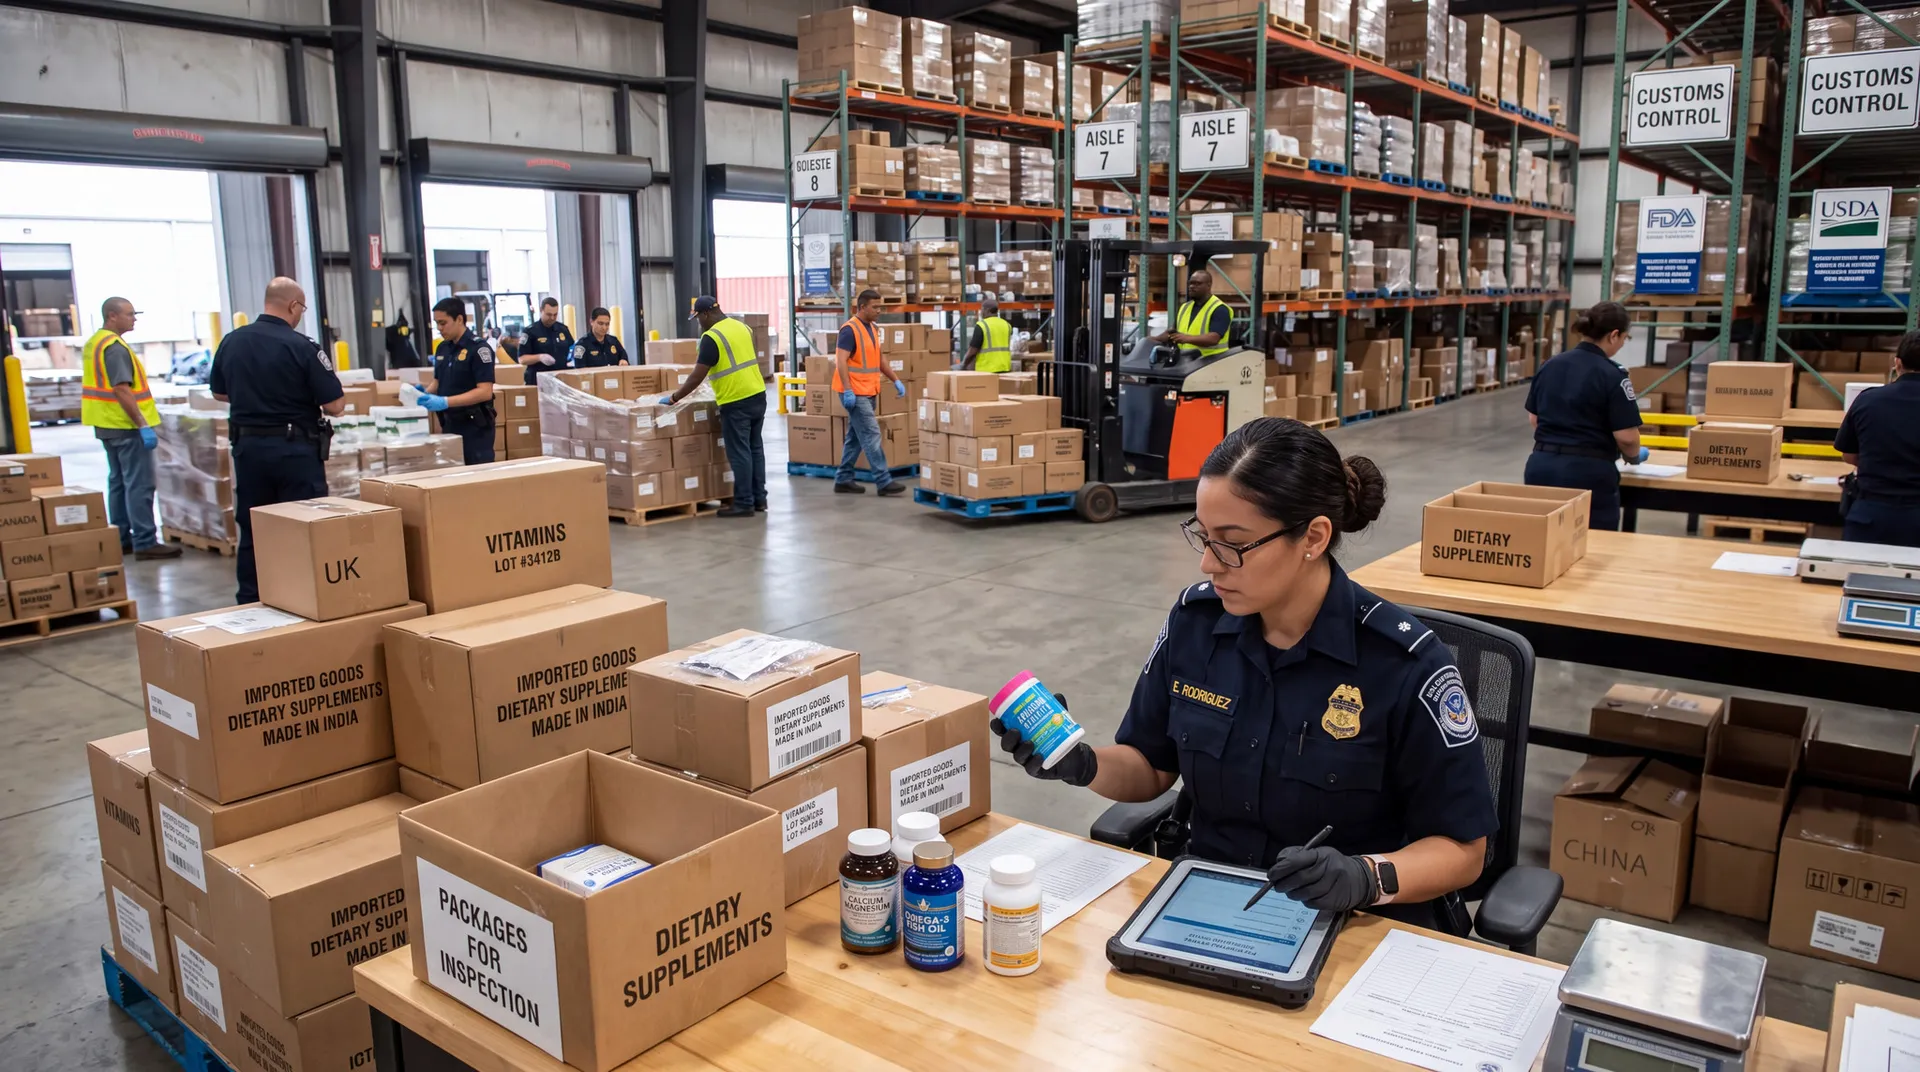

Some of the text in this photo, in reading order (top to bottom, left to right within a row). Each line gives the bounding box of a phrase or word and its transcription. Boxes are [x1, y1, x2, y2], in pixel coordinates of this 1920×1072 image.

[1811, 66, 1914, 91] CUSTOMS
[1637, 83, 1725, 105] CUSTOMS
[1811, 92, 1909, 116] CONTROL
[1191, 118, 1237, 139] AISLE
[1637, 108, 1721, 128] CONTROL
[1085, 127, 1125, 147] AISLE
[1099, 150, 1109, 171] 7
[1208, 141, 1218, 162] 7
[811, 175, 819, 192] 8
[1647, 208, 1697, 228] FDA
[1821, 200, 1880, 218] USDA
[1693, 456, 1762, 469] SUPPLEMENTS
[1709, 444, 1748, 456] DIETARY
[486, 523, 566, 554] VITAMINS
[1453, 529, 1512, 547] DIETARY
[11, 553, 45, 566] CHINA
[325, 557, 361, 584] UK
[495, 549, 561, 573] LOT #3412B
[1432, 545, 1532, 569] SUPPLEMENTS
[517, 646, 637, 693] IMPORTED GOODS
[244, 664, 364, 705] IMPORTED GOODS
[497, 671, 628, 723] DIETARY SUPPLEME
[1172, 680, 1232, 710] E RODRIGUEZ
[228, 681, 383, 732] DIETARY SUPPLEMENTS
[532, 695, 628, 738] MADE IN INDIA
[774, 694, 831, 724] IMPORTED GOODS
[774, 700, 845, 736] DIETARY SUPPLEMENTS
[263, 709, 359, 747] MADE IN INDIA
[775, 720, 822, 747] MADE IN INDIA
[900, 759, 954, 787] IMPORTED GOODS
[900, 763, 967, 797] DIETARY SUPPLEMENTS
[900, 783, 944, 807] MADE IN INDIA
[102, 796, 141, 837] VITAMINS
[786, 819, 799, 831] LOT
[786, 830, 798, 842] LOT
[1563, 839, 1647, 877] CHINA
[331, 888, 405, 928] IMPORTED
[844, 900, 890, 912] MAGNESIUM
[848, 895, 884, 905] CALCIUM
[438, 886, 528, 954] PACKAGES
[656, 892, 742, 957] DIETARY
[906, 920, 946, 933] FISH OIL
[310, 921, 370, 958] DIETARY
[346, 929, 407, 967] MADE IN
[467, 934, 502, 974] FOR
[623, 911, 773, 1009] SUPPLEMENTS
[440, 949, 540, 1028] INSPECTION
